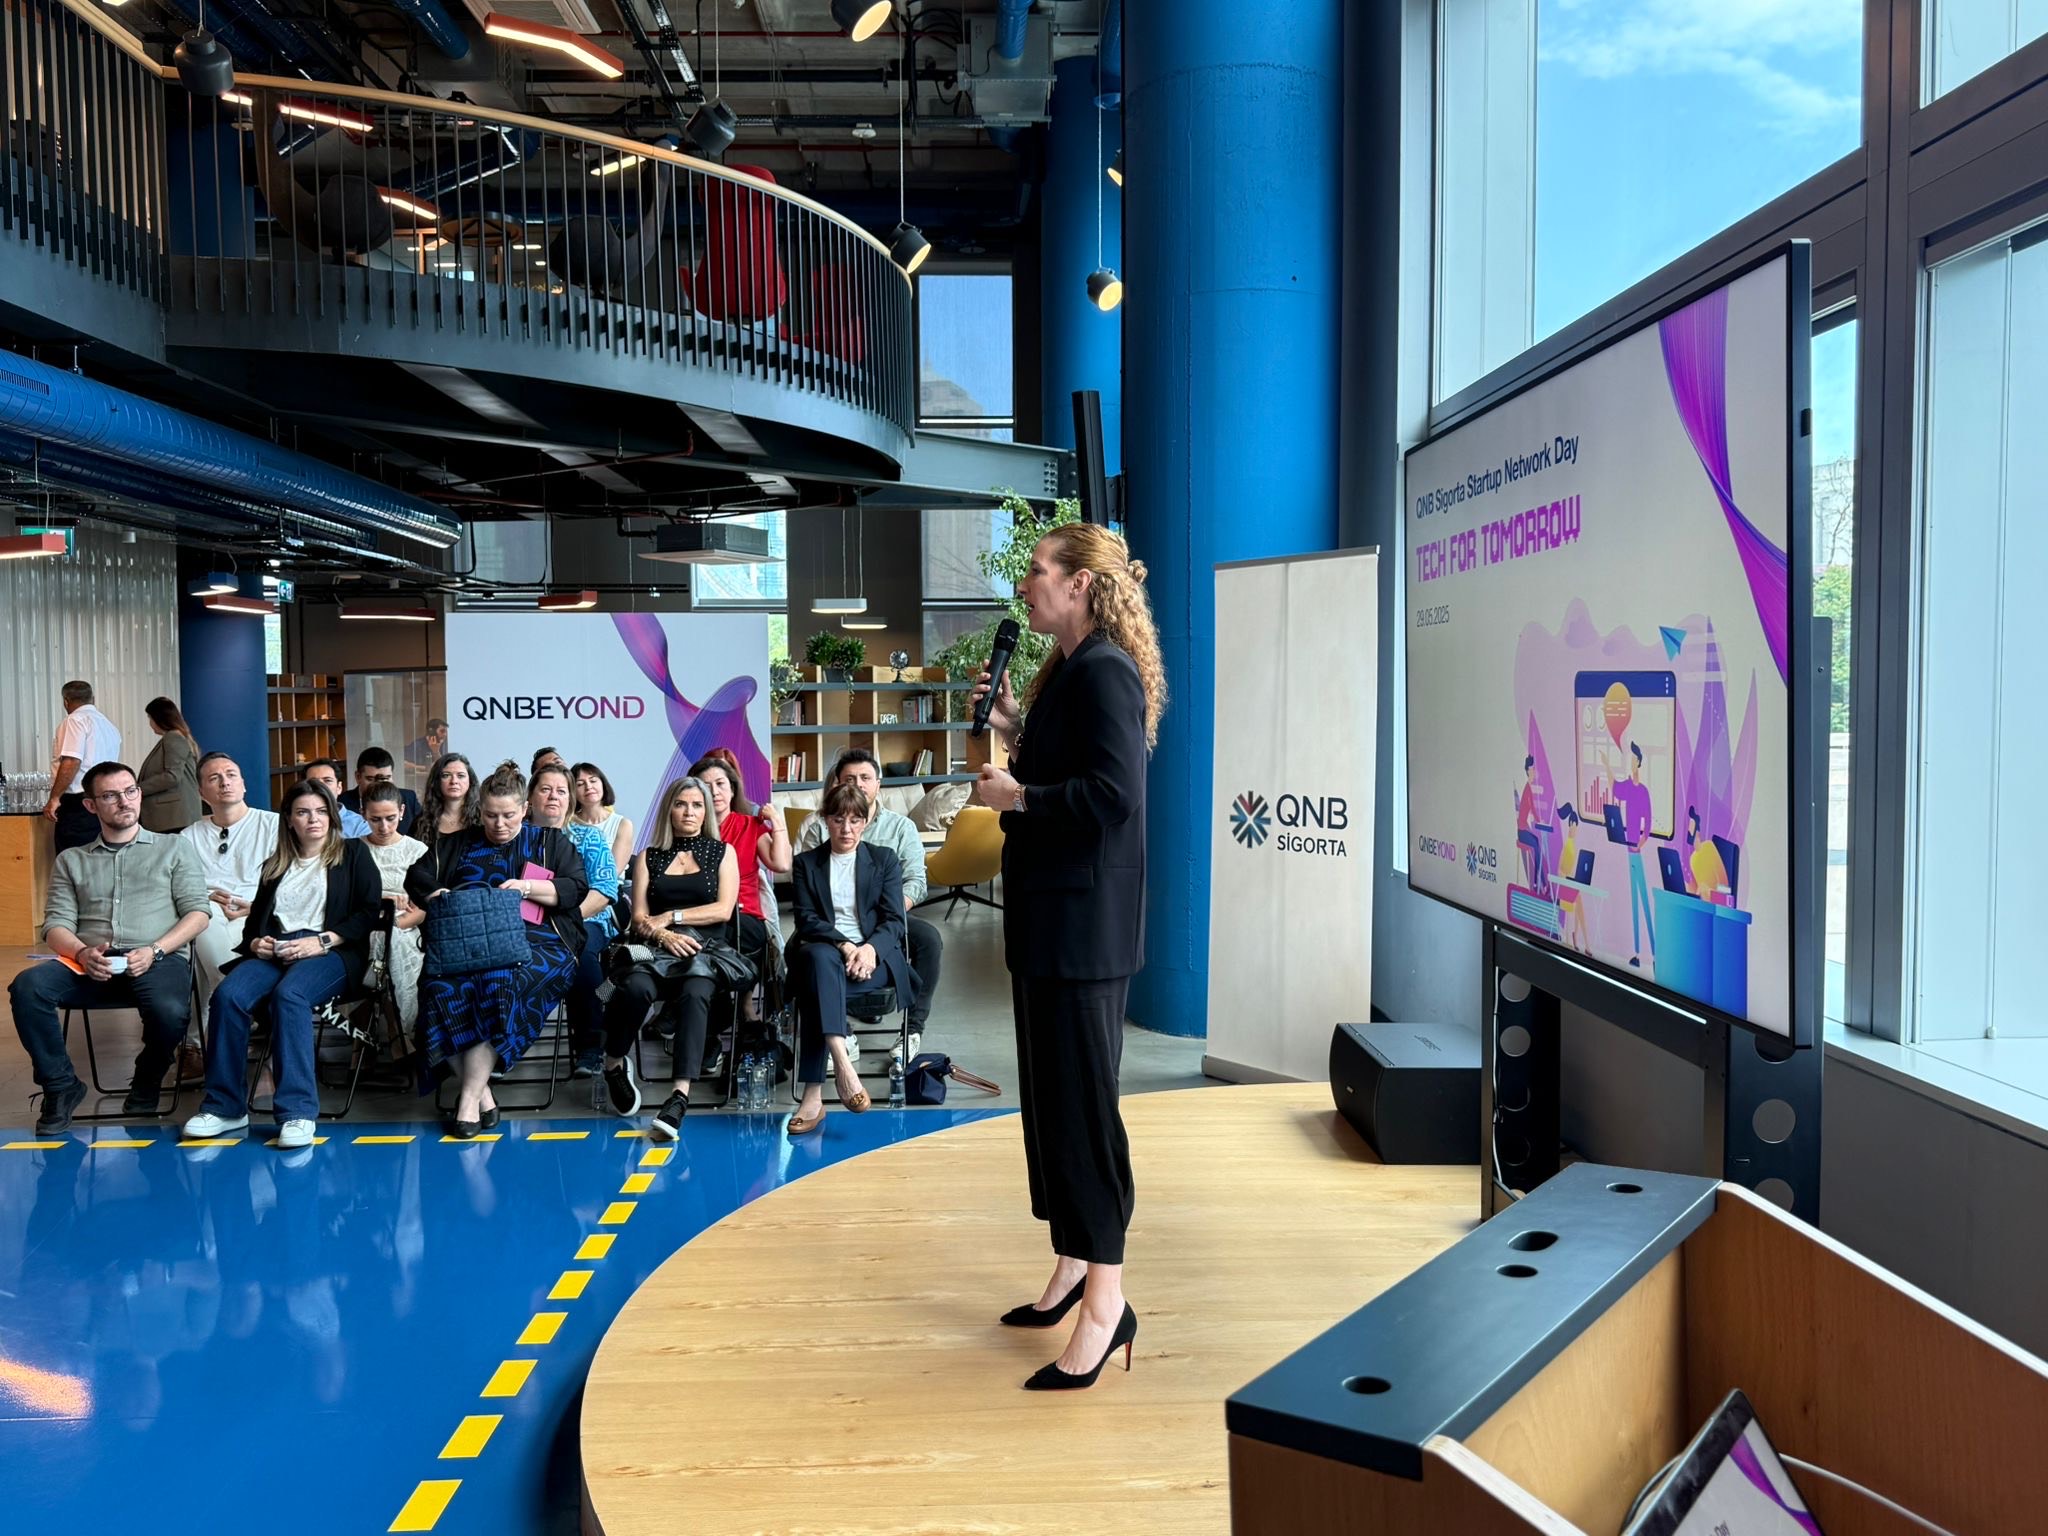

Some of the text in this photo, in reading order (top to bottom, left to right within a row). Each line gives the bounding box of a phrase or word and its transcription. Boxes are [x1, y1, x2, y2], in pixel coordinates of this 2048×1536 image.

[1416, 435, 1579, 519] QNB Sigorta Startup Network Day
[1416, 494, 1581, 583] TECH FOR TOMORROW
[1416, 605, 1450, 628] 29.05.2025
[463, 696, 645, 721] QNBEYOND
[1276, 793, 1348, 830] QNB
[1418, 835, 1456, 862] QNBEYOND
[1477, 845, 1497, 868] QNB
